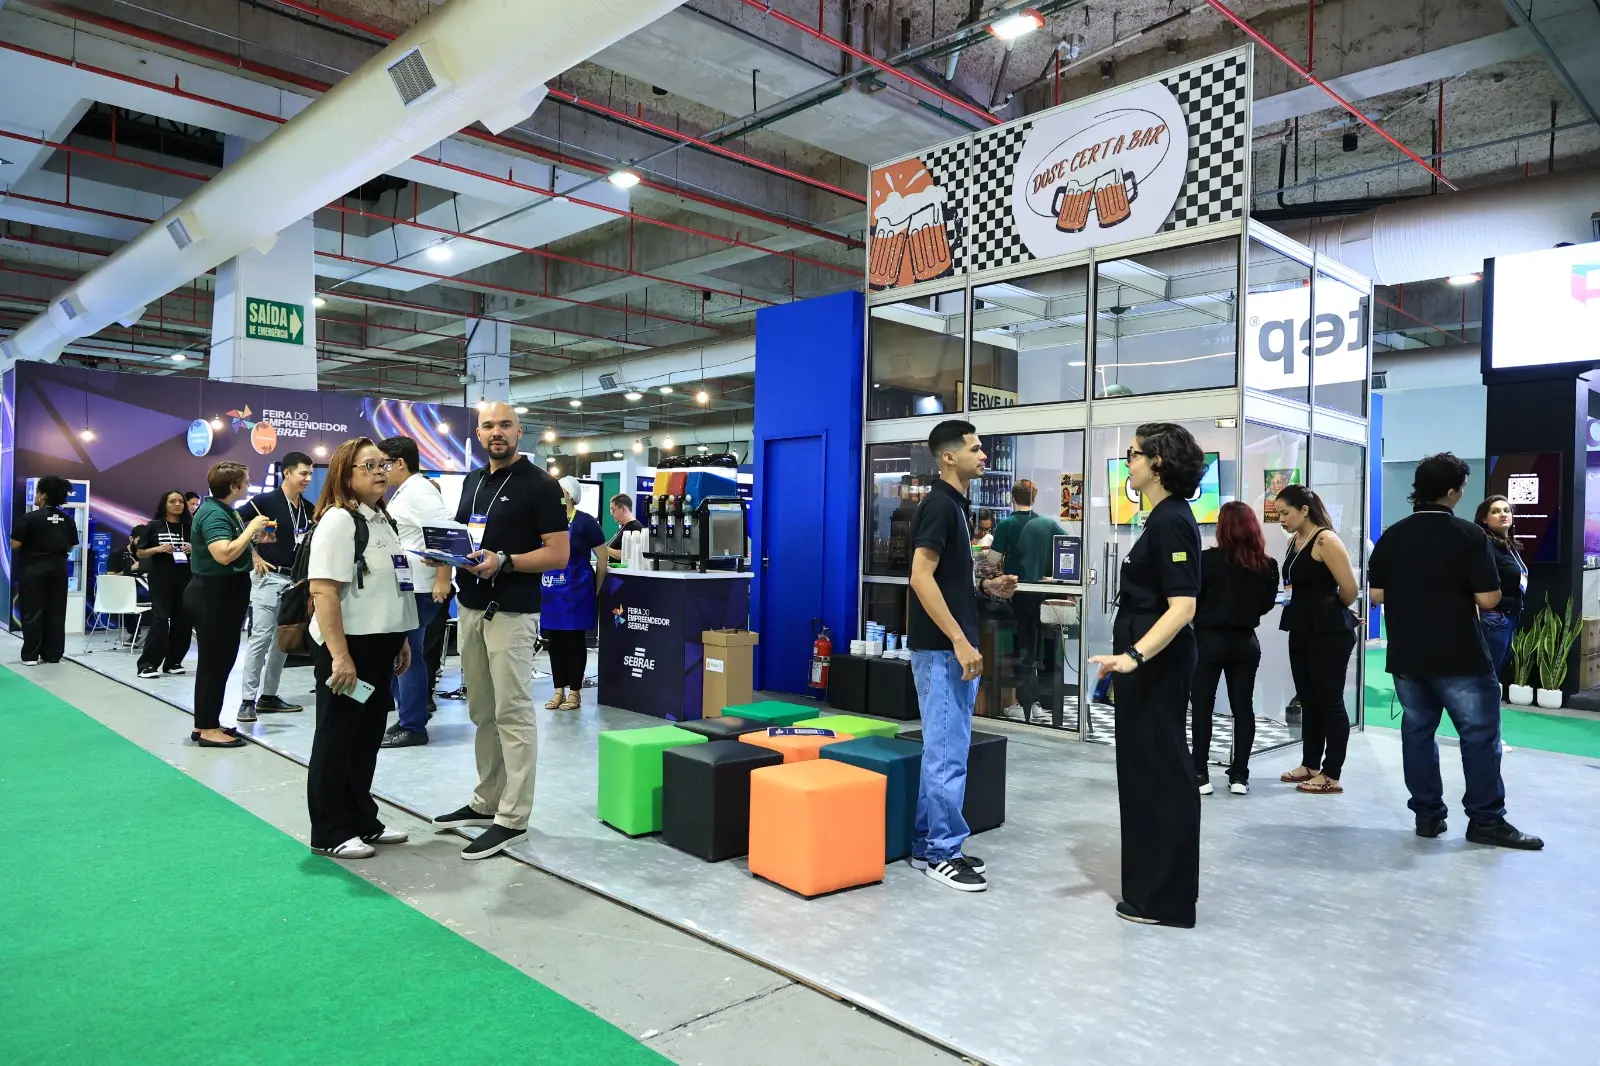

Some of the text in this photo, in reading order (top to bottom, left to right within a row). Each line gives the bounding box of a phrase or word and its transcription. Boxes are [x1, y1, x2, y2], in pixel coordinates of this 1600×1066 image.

[1031, 158, 1069, 195] DOSE
[1126, 124, 1166, 151] BAR
[249, 303, 288, 327] SAÍDA
[249, 326, 288, 339] DE EMERGÊNCIA
[971, 391, 1014, 409] ERVEJA
[262, 409, 309, 421] FEIRA DO
[262, 417, 348, 433] EMPREENDEDOR
[627, 607, 650, 616] FEIRA DO
[627, 614, 671, 627] EMPREENDEDOR
[627, 622, 649, 632] SEBRAE
[623, 655, 656, 670] SEBRAE
